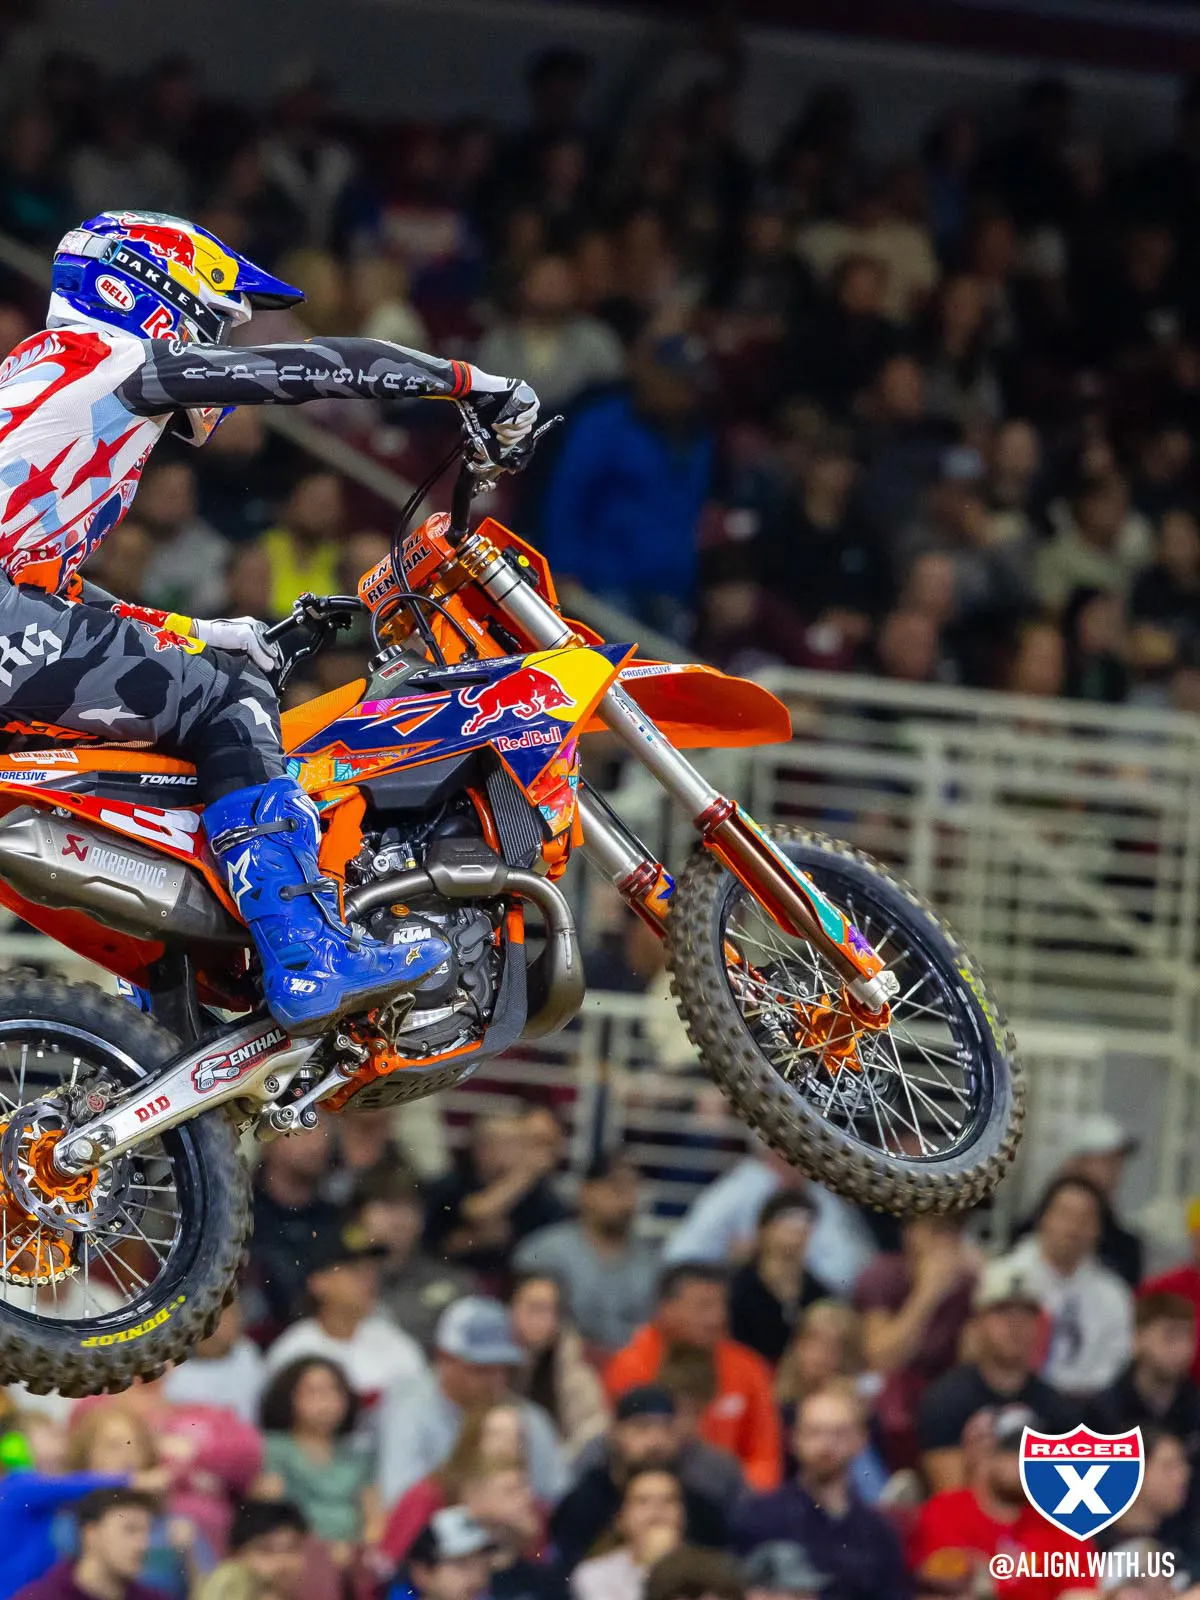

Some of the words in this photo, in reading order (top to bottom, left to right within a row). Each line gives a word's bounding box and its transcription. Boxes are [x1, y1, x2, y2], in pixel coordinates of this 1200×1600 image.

[100, 278, 129, 308] BELL
[116, 251, 205, 317] OAKLEY
[366, 546, 432, 605] RENHAL
[621, 665, 672, 679] PROGRESSIVE
[498, 731, 531, 752] Red
[530, 726, 562, 746] Bull
[140, 774, 198, 786] TOMAC
[393, 926, 432, 945] KTM
[80, 1307, 171, 1347] DUNLOP
